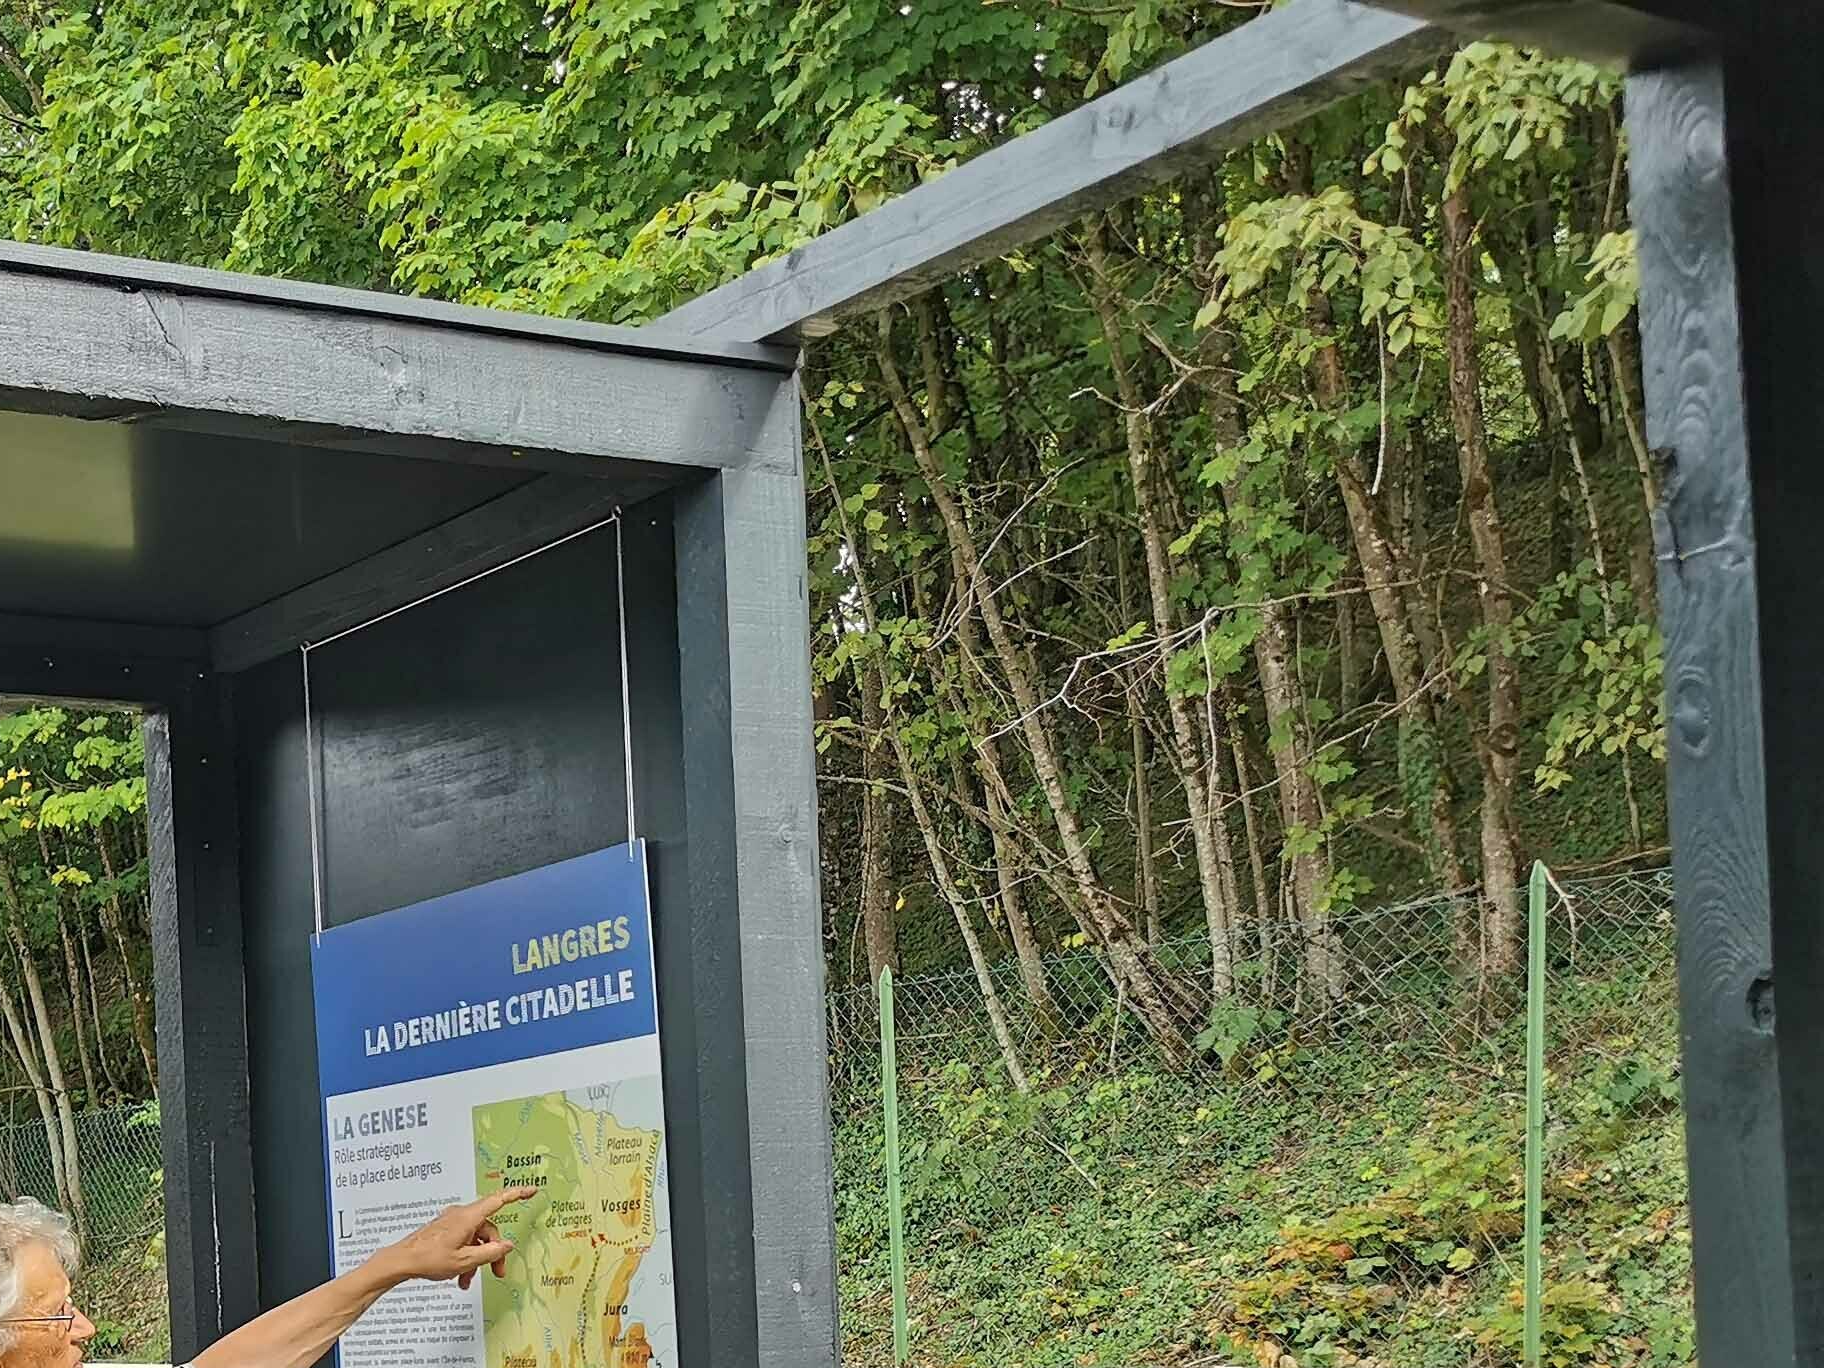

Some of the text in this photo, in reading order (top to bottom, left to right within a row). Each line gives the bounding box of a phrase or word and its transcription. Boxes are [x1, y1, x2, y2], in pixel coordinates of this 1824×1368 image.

[511, 916, 631, 975] LANGRES
[364, 969, 635, 1057] LA DERNIÈRE CITADELLE
[333, 1102, 428, 1142] LA GENESE
[607, 1137, 643, 1151] Plateau
[334, 1141, 413, 1165] Rôle stratégique
[506, 1151, 542, 1169] Bassin
[608, 1151, 641, 1166] lorrain
[335, 1161, 443, 1188] de la place de Langres
[503, 1173, 547, 1188] Parisien
[551, 1200, 585, 1213] Plateau
[601, 1199, 641, 1214] Vosges
[541, 1275, 575, 1286] Morvan
[603, 1303, 628, 1316] Jura
